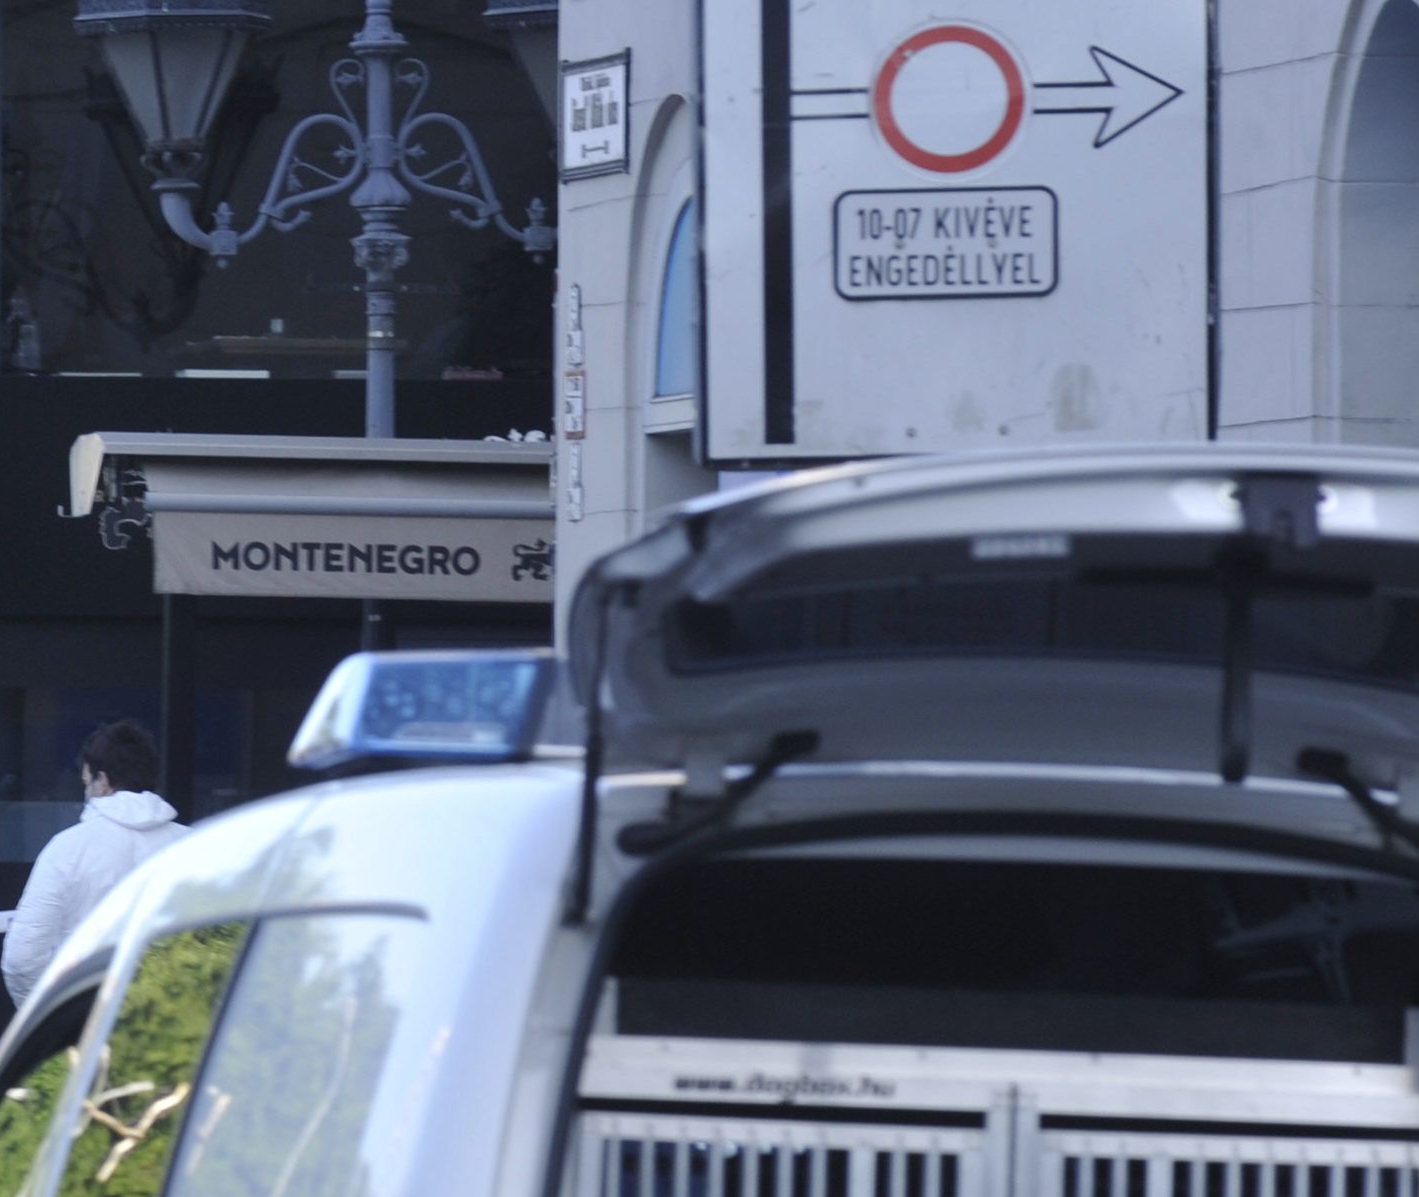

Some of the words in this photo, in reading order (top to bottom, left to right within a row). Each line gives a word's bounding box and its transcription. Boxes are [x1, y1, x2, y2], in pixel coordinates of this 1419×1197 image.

[856, 207, 922, 240] 10-07
[934, 196, 1032, 239] KIVÉVE
[849, 245, 1041, 287] ENGEDÉLLYEL
[212, 539, 480, 576] MONTENEGRO
